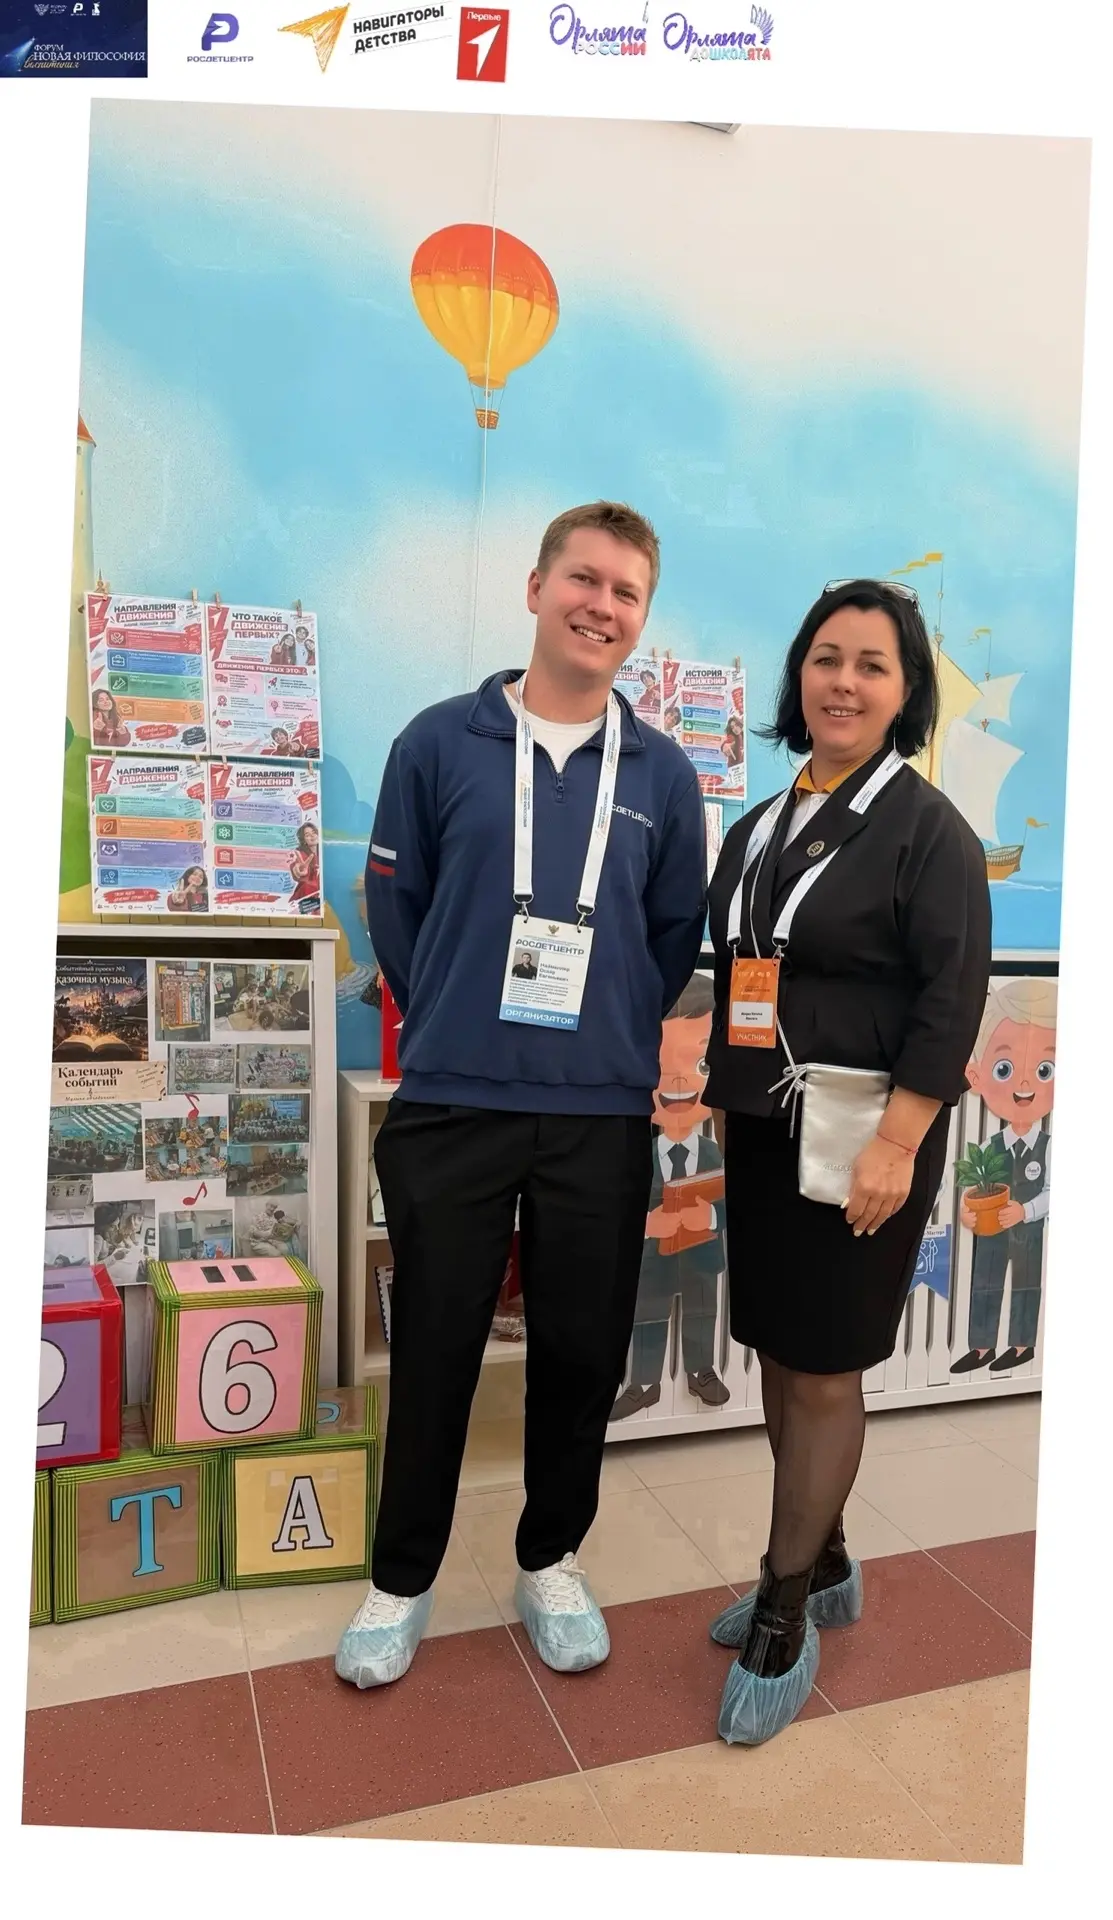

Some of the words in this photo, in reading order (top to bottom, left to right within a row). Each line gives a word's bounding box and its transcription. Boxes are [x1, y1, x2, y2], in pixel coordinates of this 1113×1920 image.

[114, 603, 176, 613] НАПРАВЛЕНИЯ
[118, 611, 174, 622] ДВИЖЕНИЯ
[232, 612, 251, 620] ЧТО
[254, 614, 282, 622] ТАКОЕ
[233, 621, 288, 631] ДВИЖЕНИЕ
[217, 662, 256, 671] ДВИЖЕНИЕ
[620, 664, 633, 672] ИЯ
[684, 677, 726, 686] ДВИЖЕНИЯ
[116, 765, 180, 775] НАПРАВЛЕНИЯ
[122, 774, 176, 784] ДВИЖЕНИЯ
[238, 778, 291, 786] ДВИЖЕНИЯ
[612, 803, 652, 828] СДЕТЦЕТР
[516, 938, 584, 955] РОСДЕТЦЕНТР
[56, 976, 97, 986] казочная
[100, 977, 132, 986] музыка
[505, 1008, 574, 1024] ОРГАНИЗАТОР
[736, 1033, 767, 1042] УЧАСТНИК
[58, 1067, 123, 1079] Календарь
[65, 1076, 117, 1088] событий
[199, 1320, 278, 1434] 6
[272, 1476, 334, 1552] А
[110, 1485, 182, 1578] Т
